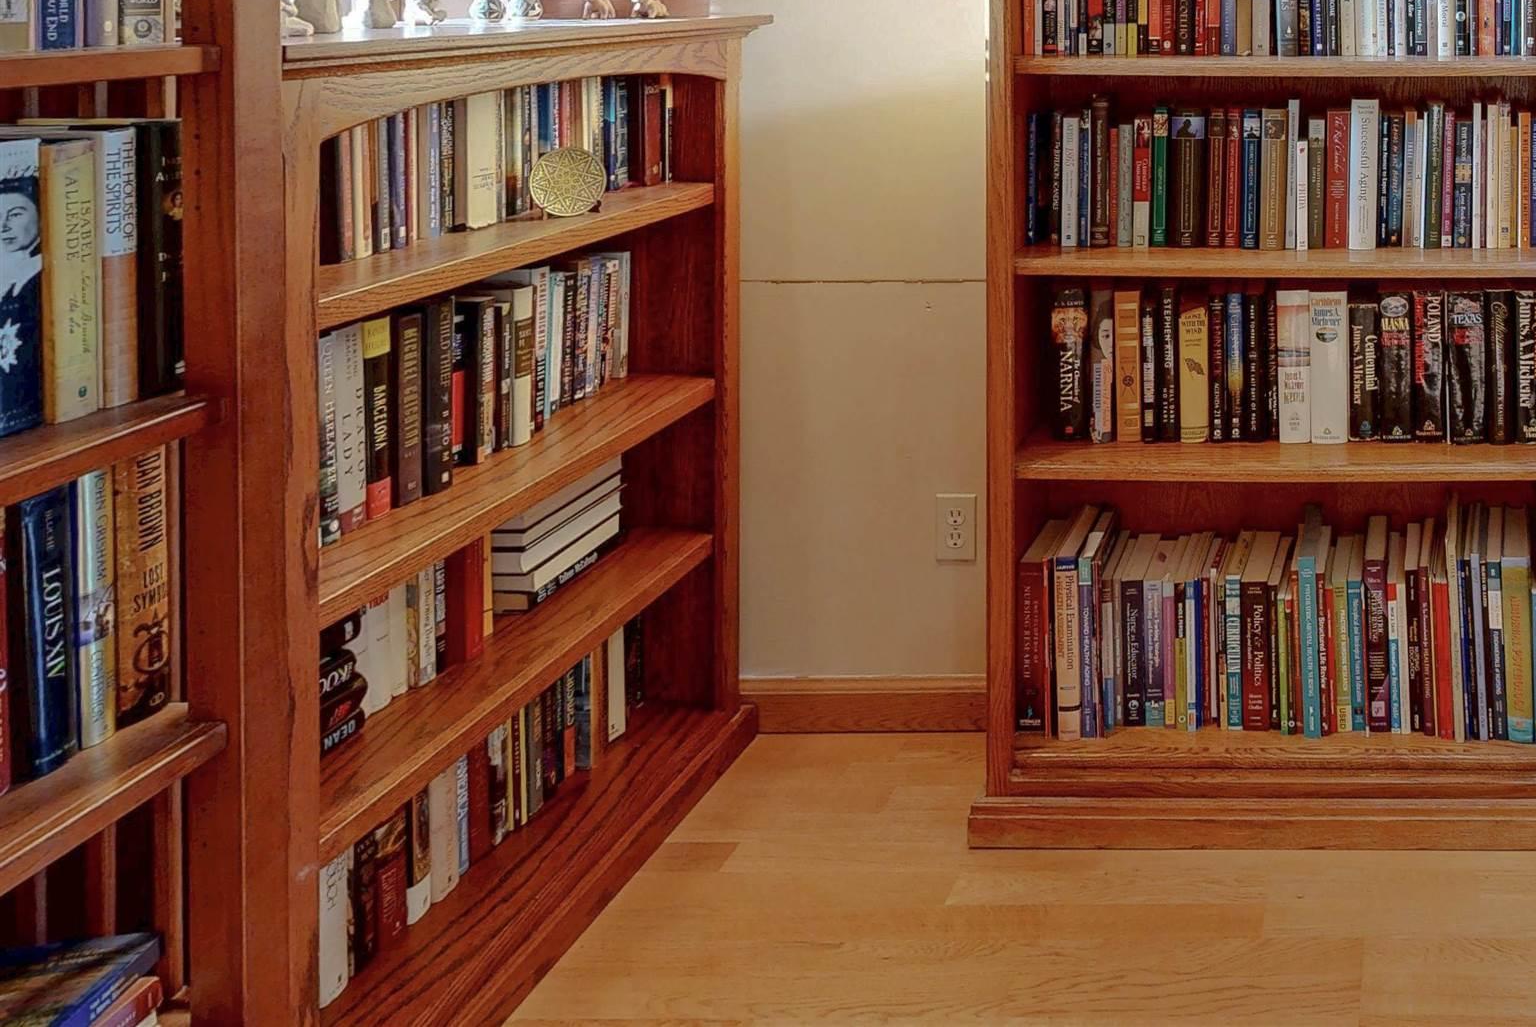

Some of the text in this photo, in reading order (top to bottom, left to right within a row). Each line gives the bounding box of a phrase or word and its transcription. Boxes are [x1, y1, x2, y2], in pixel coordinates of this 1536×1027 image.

[46, 16, 58, 41] END
[1164, 4, 1172, 34] BRIDA
[1179, 0, 1188, 39] COELHO
[1334, 116, 1342, 173] The Red Chamber
[1359, 118, 1369, 201] Successful Aging
[65, 176, 79, 262] ALLENDE
[106, 149, 121, 235] THE SPIRITS
[122, 138, 134, 242] THE HOUSE OF
[80, 199, 92, 263] ISABEL
[1427, 296, 1441, 342] POLAND
[1454, 314, 1483, 324] TEXAS
[403, 327, 421, 448] MICHAEL CRICHTON
[1060, 351, 1073, 411] NARNIA
[1365, 335, 1377, 390] Centennial
[323, 339, 337, 485] QUEEN HEREAFTER
[354, 387, 366, 490] DRAGON
[373, 385, 387, 451] BARCELONA
[342, 413, 353, 478] LADY
[95, 472, 109, 582] JOHN GRISHAM
[135, 454, 163, 553] DAN BROWN
[142, 569, 164, 589] LOST
[41, 565, 65, 680] LOUIS XIV
[1023, 586, 1031, 678] NURSING RESEARCH
[1064, 575, 1075, 670] Physical Examination
[1226, 618, 1239, 672] CURRICULUM
